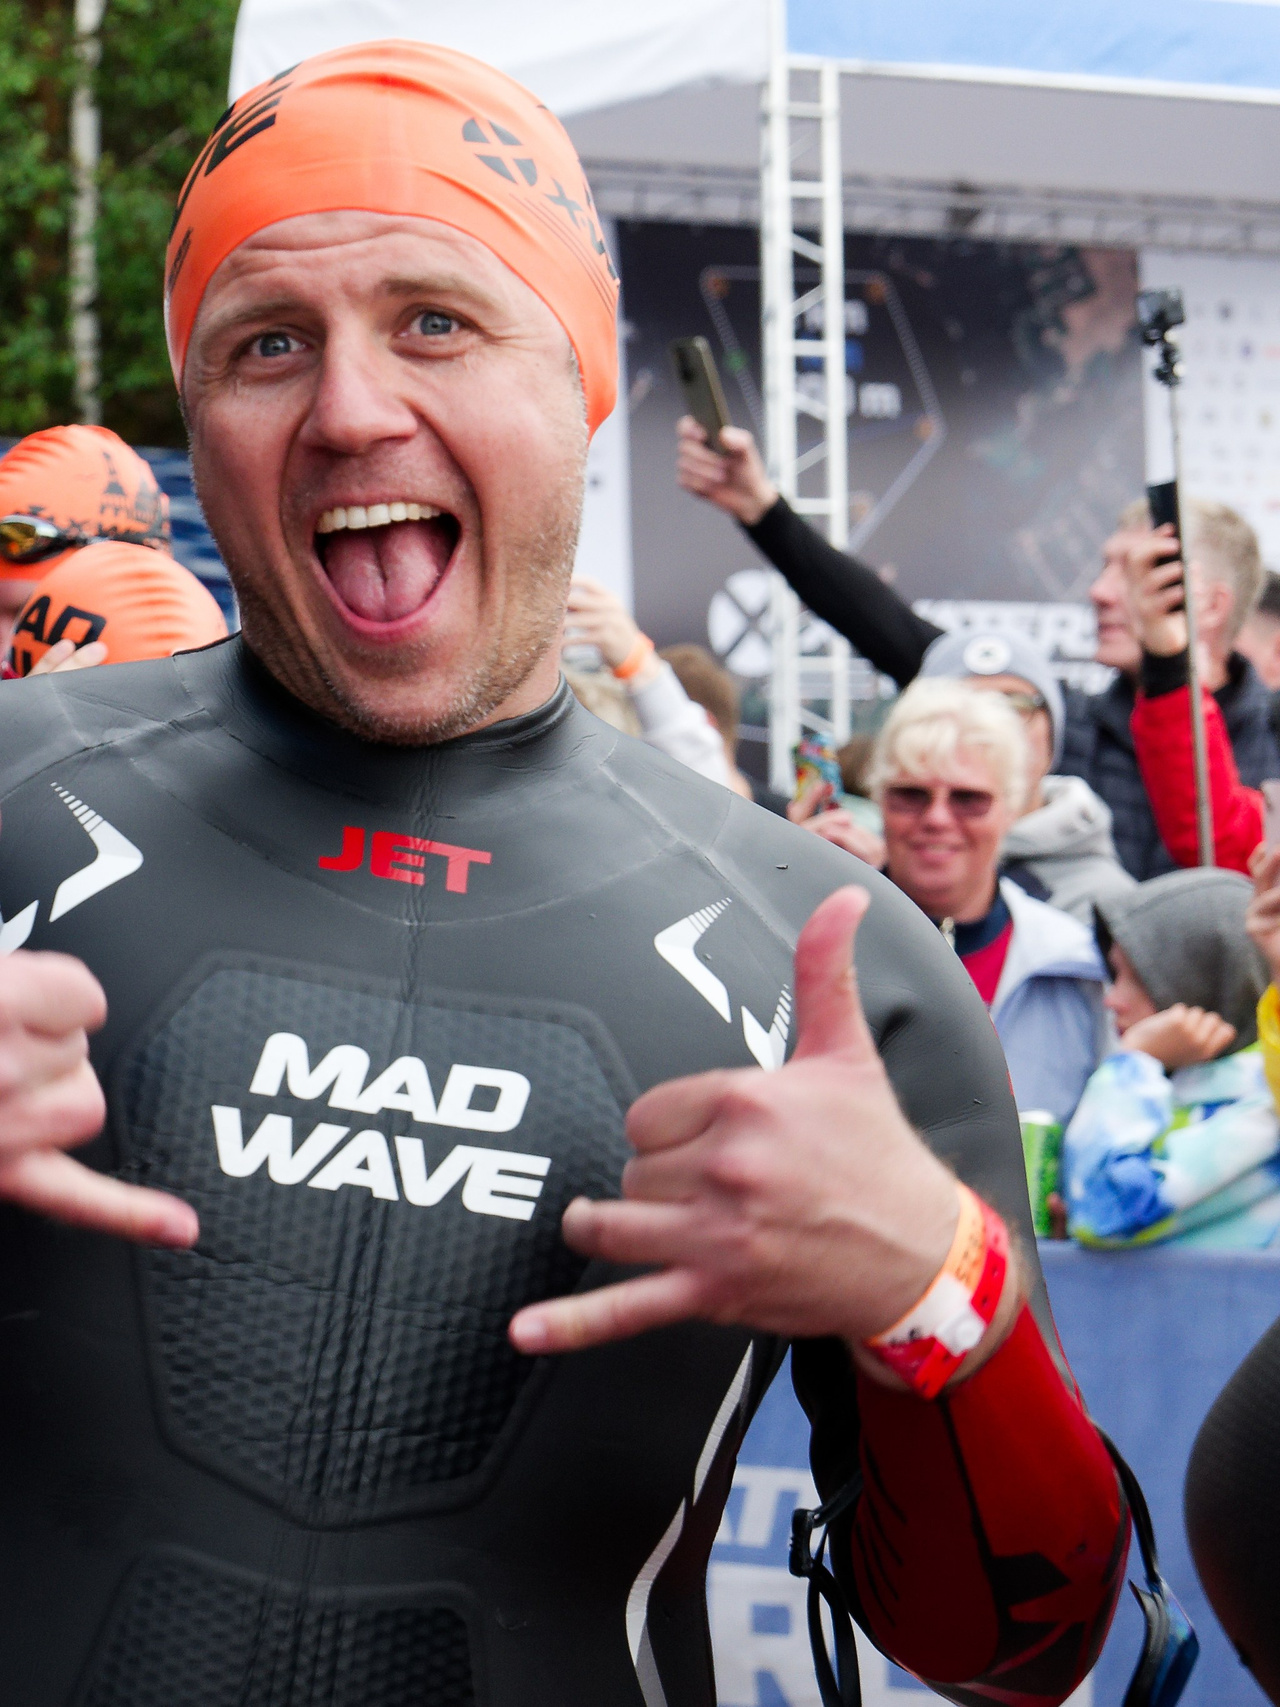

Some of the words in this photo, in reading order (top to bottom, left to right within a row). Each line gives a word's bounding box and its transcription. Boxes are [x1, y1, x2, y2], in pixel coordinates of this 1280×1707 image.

[13, 595, 107, 651] AD
[318, 825, 492, 894] JET
[249, 1031, 531, 1133] MAD
[211, 1104, 552, 1221] WAVE
